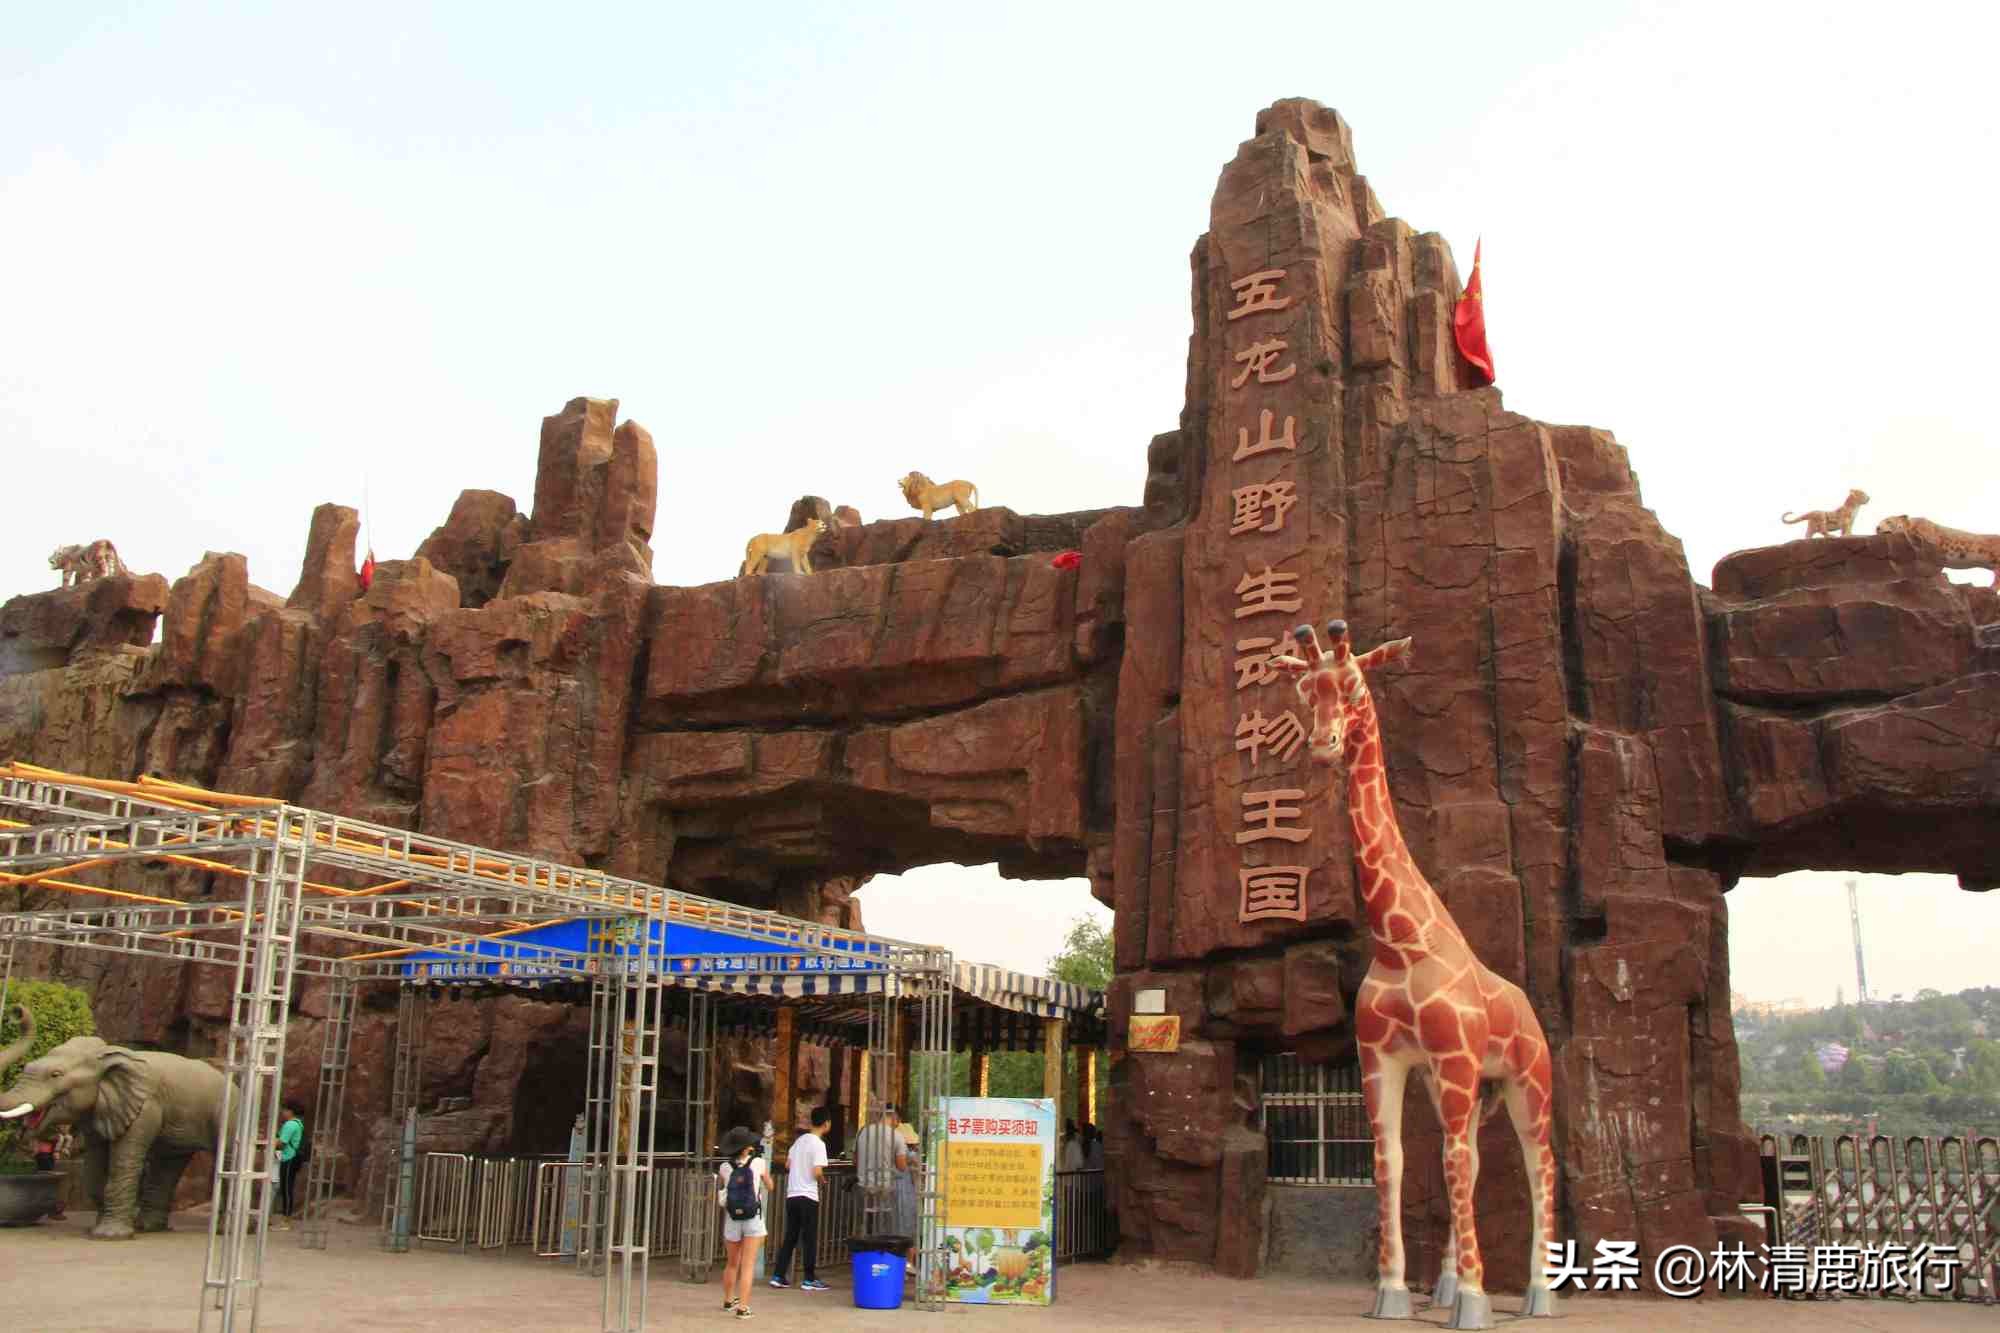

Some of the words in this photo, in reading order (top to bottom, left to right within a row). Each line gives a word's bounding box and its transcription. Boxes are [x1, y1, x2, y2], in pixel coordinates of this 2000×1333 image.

[1227, 269, 1312, 923] 五龙山野生动物王国
[947, 1118, 1038, 1137] 电子票购买须知
